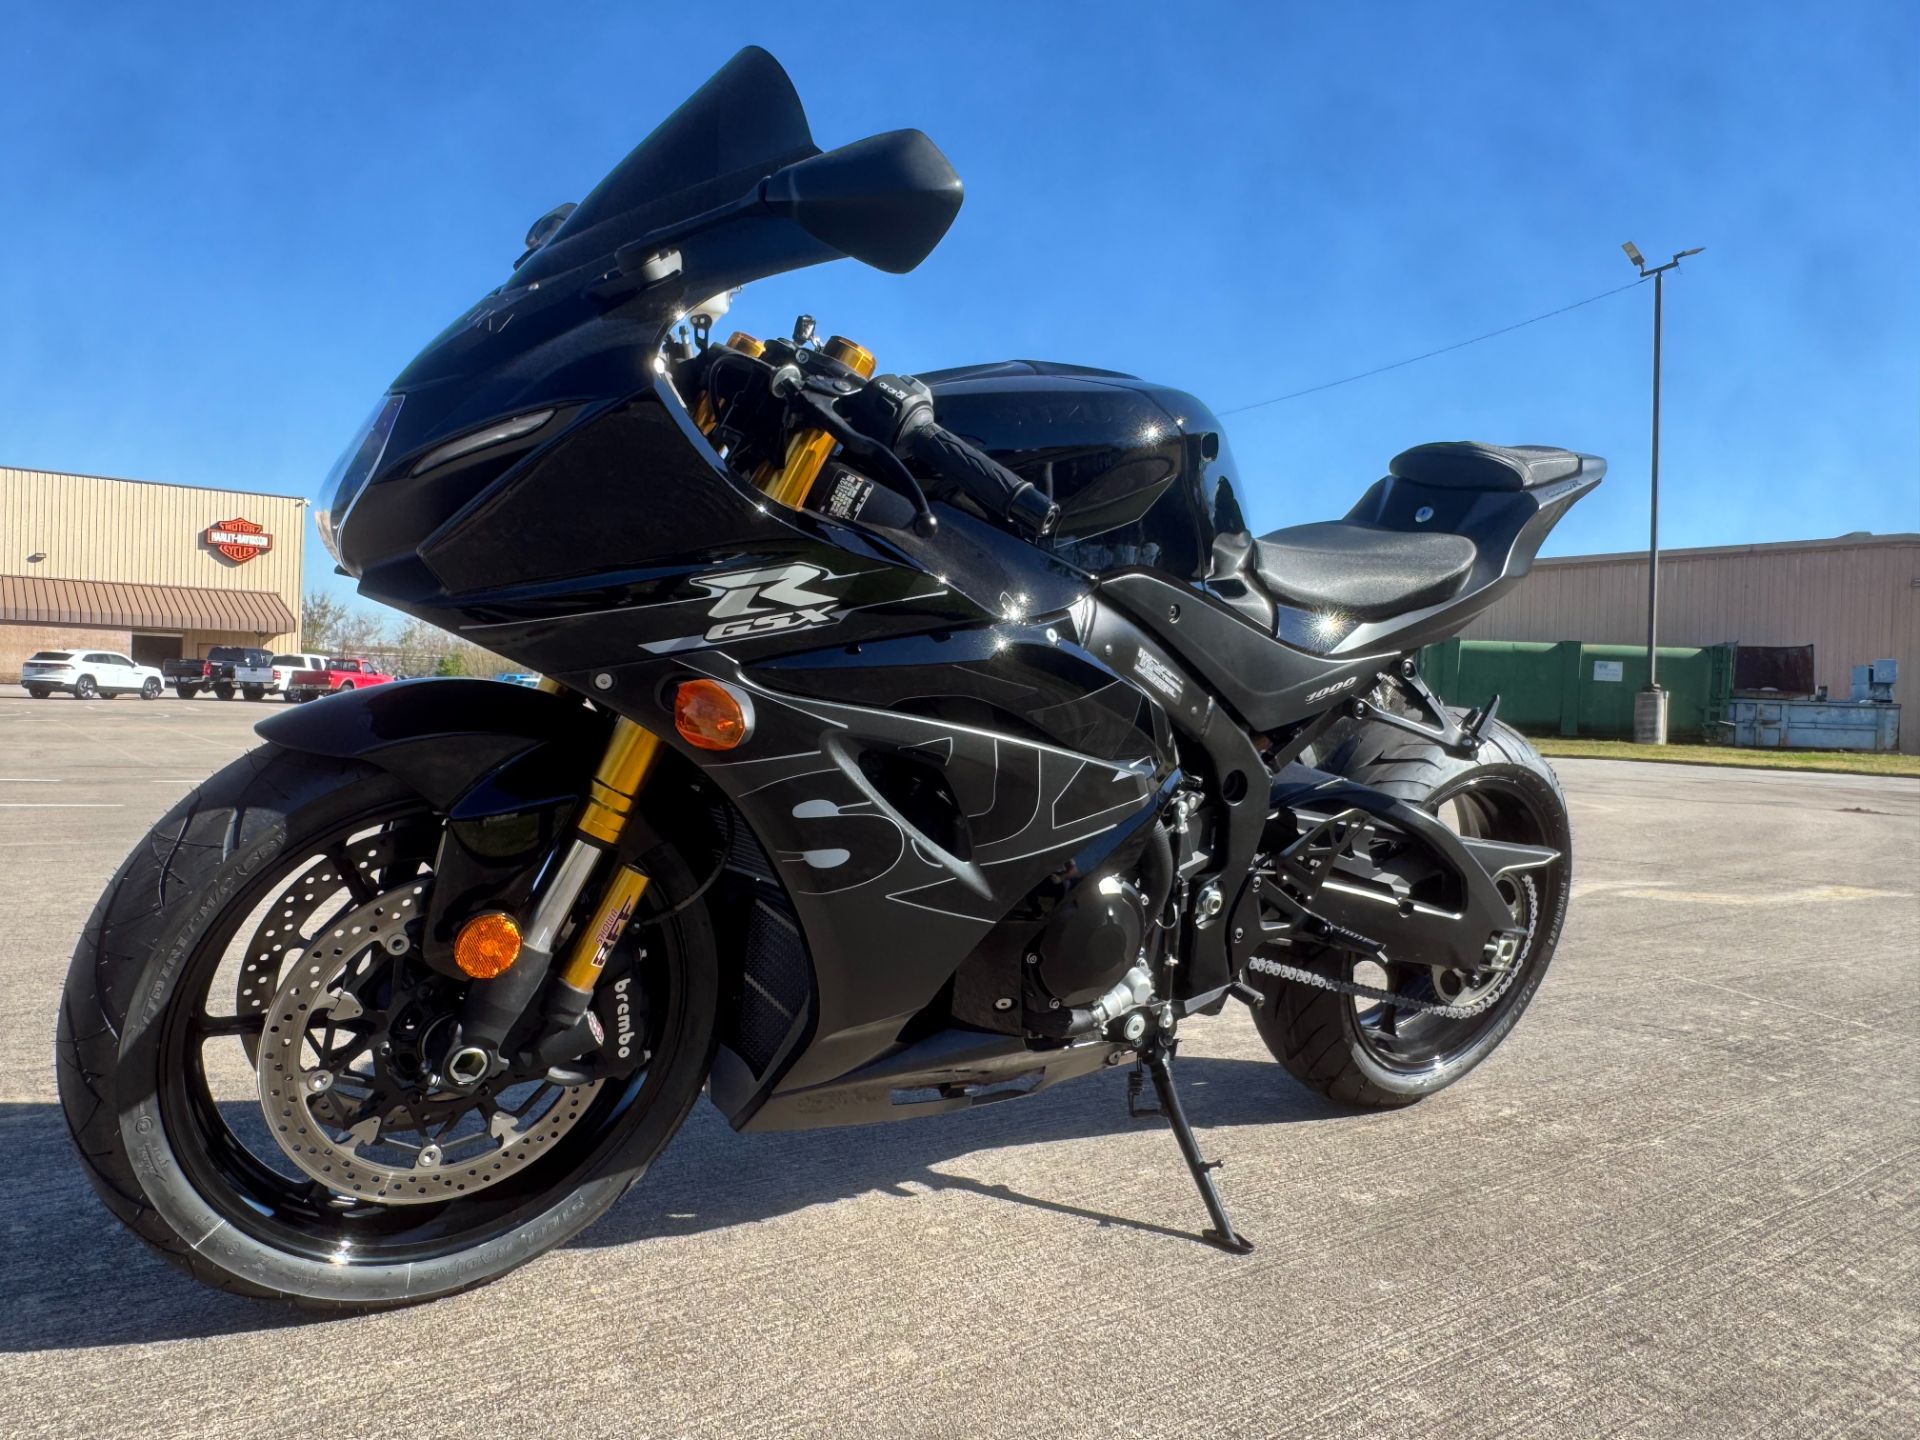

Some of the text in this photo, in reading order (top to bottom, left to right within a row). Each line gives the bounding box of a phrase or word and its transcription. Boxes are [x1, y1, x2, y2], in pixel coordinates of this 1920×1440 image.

[224, 521, 256, 534] MOTOR
[704, 604, 839, 640] GSX
[1305, 676, 1357, 704] 1000
[614, 977, 636, 1059] brembo
